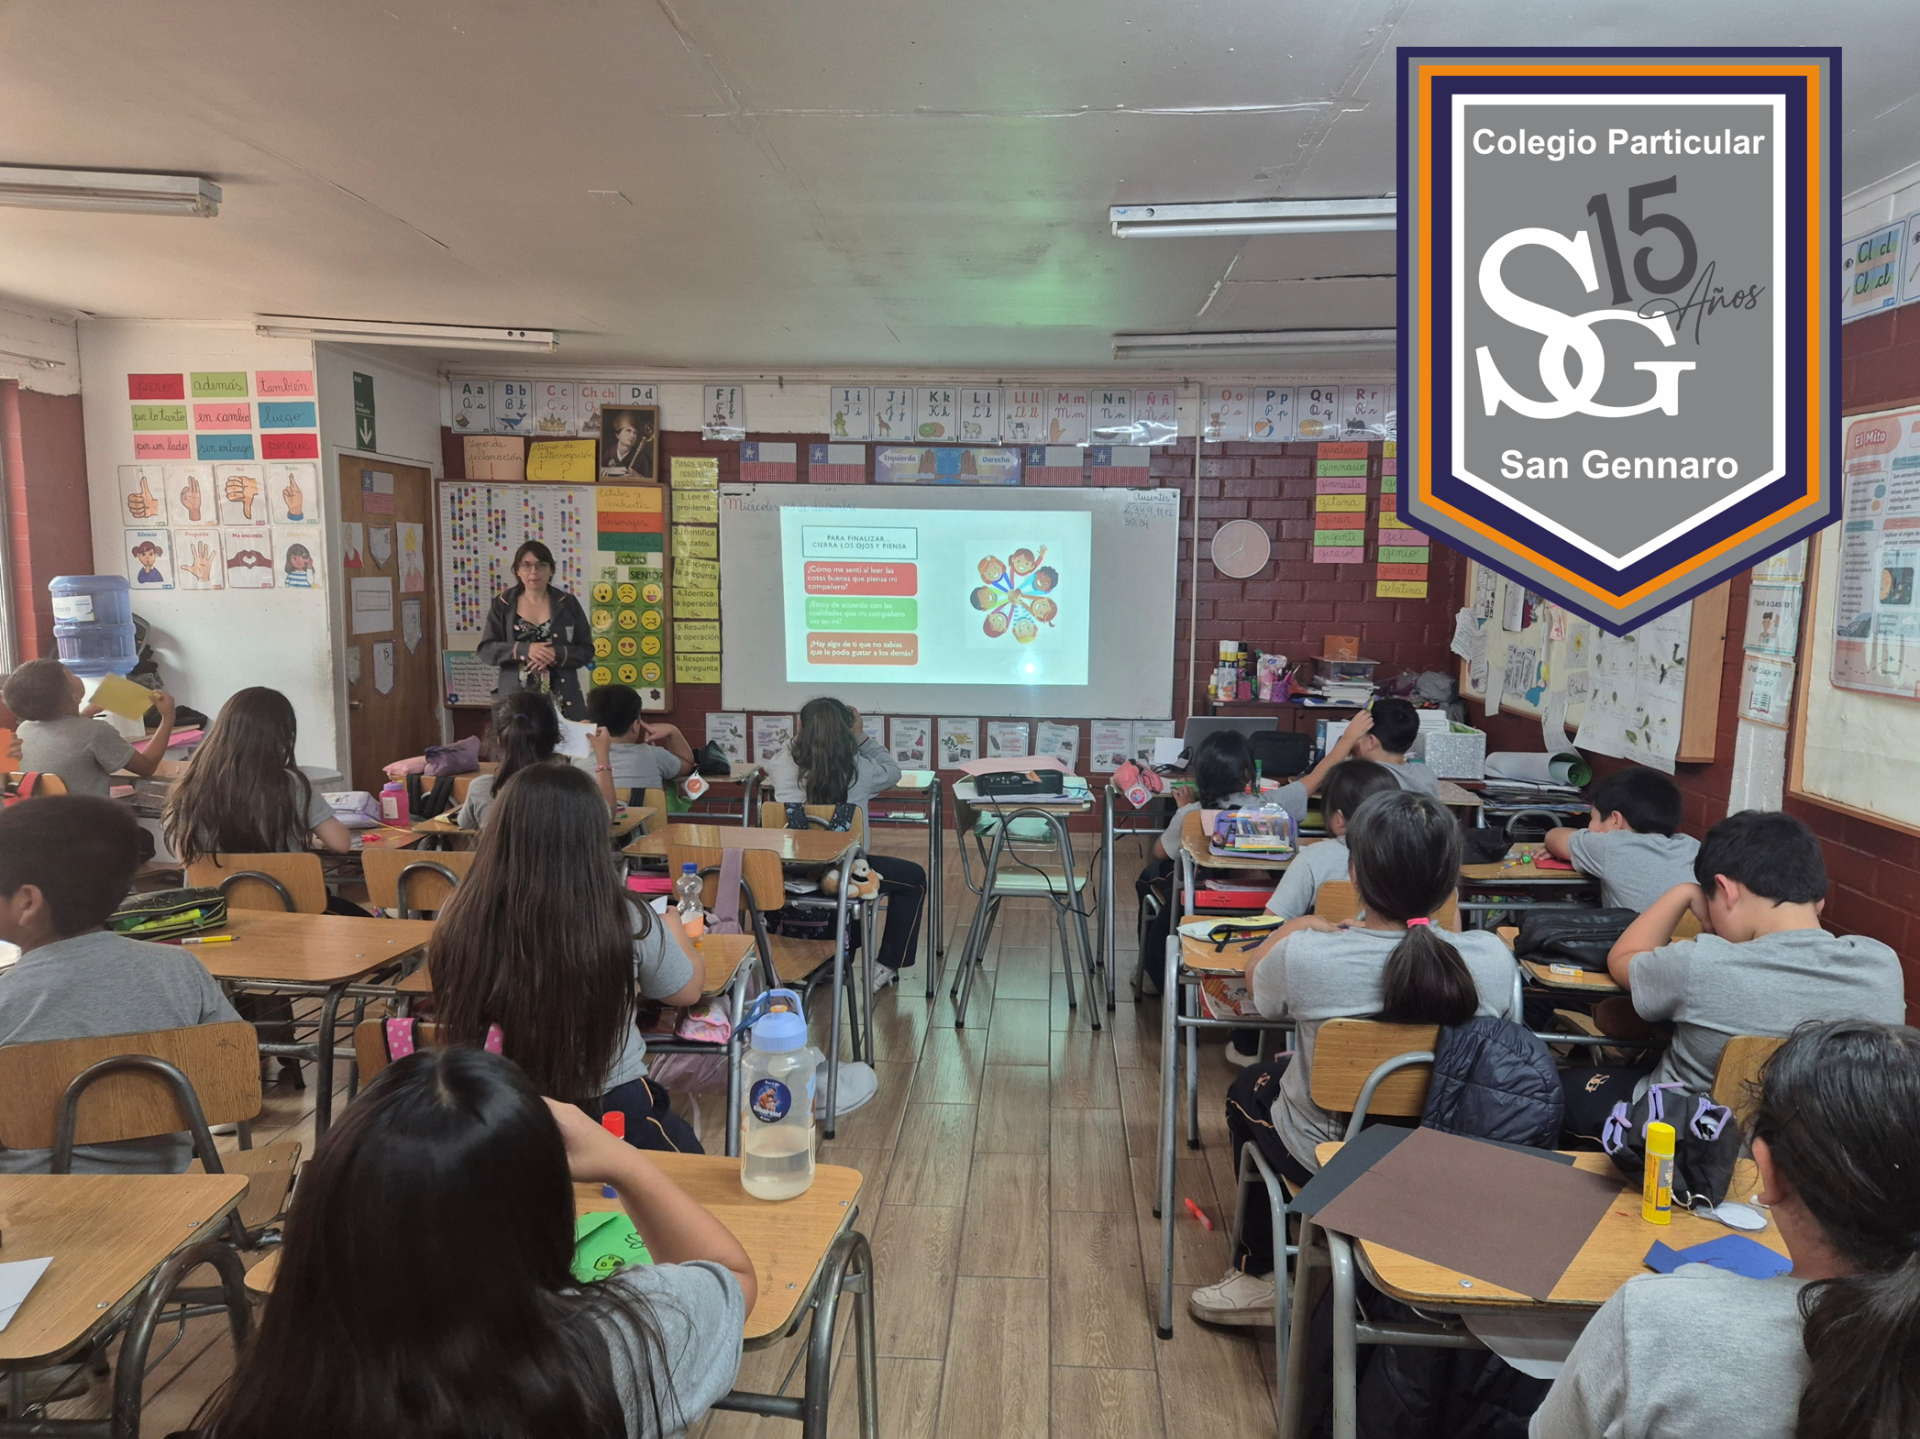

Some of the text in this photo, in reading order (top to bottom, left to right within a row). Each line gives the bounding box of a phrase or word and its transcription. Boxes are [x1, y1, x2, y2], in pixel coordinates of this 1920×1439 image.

[1859, 231, 1891, 263] Cl cl
[138, 380, 176, 396] pero
[194, 377, 244, 391] además
[260, 378, 309, 393] también
[463, 384, 471, 394] A
[506, 385, 526, 395] B b
[548, 385, 555, 395] C
[582, 387, 615, 398] Ch ch
[632, 388, 652, 399] D d
[717, 389, 735, 402] F f
[1311, 390, 1332, 403] Q q
[133, 407, 185, 427] por lo tanto
[197, 408, 250, 423] en cambio
[265, 406, 305, 426] luego
[1855, 430, 1886, 448] El Mito
[136, 442, 150, 455] por
[167, 437, 188, 450] lado
[198, 439, 252, 459] sin embargo
[268, 440, 311, 458] porque
[469, 451, 522, 461] exclamación
[540, 450, 595, 464] interrogación
[1320, 462, 1366, 473] gimnasio
[1319, 479, 1362, 492] gimnasta
[724, 497, 780, 512] Miércoles
[1320, 496, 1360, 508] gitana
[1319, 532, 1357, 544] gigante
[1385, 531, 1409, 544] gel
[616, 554, 646, 564] ¿CÓMO
[1319, 548, 1356, 561] girasol
[1383, 548, 1420, 561] genio
[604, 570, 615, 579] ME
[685, 571, 717, 580] pregunta
[808, 565, 831, 574] ¿Cómo
[846, 565, 861, 573] sentí
[1380, 565, 1423, 577] general
[808, 583, 848, 591] compañero?
[1381, 582, 1424, 595] gelatina
[683, 600, 717, 608] operación
[810, 601, 829, 609] ¿Estoy
[842, 601, 867, 609] acuerdo
[868, 611, 905, 619] compañero
[684, 633, 719, 642] operación
[810, 640, 826, 648] ¿Hay
[676, 655, 718, 663] 6.Responde
[832, 649, 850, 657] podía
[890, 649, 914, 657] demás?
[686, 665, 718, 673] pregunta
[1759, 667, 1771, 677] page
